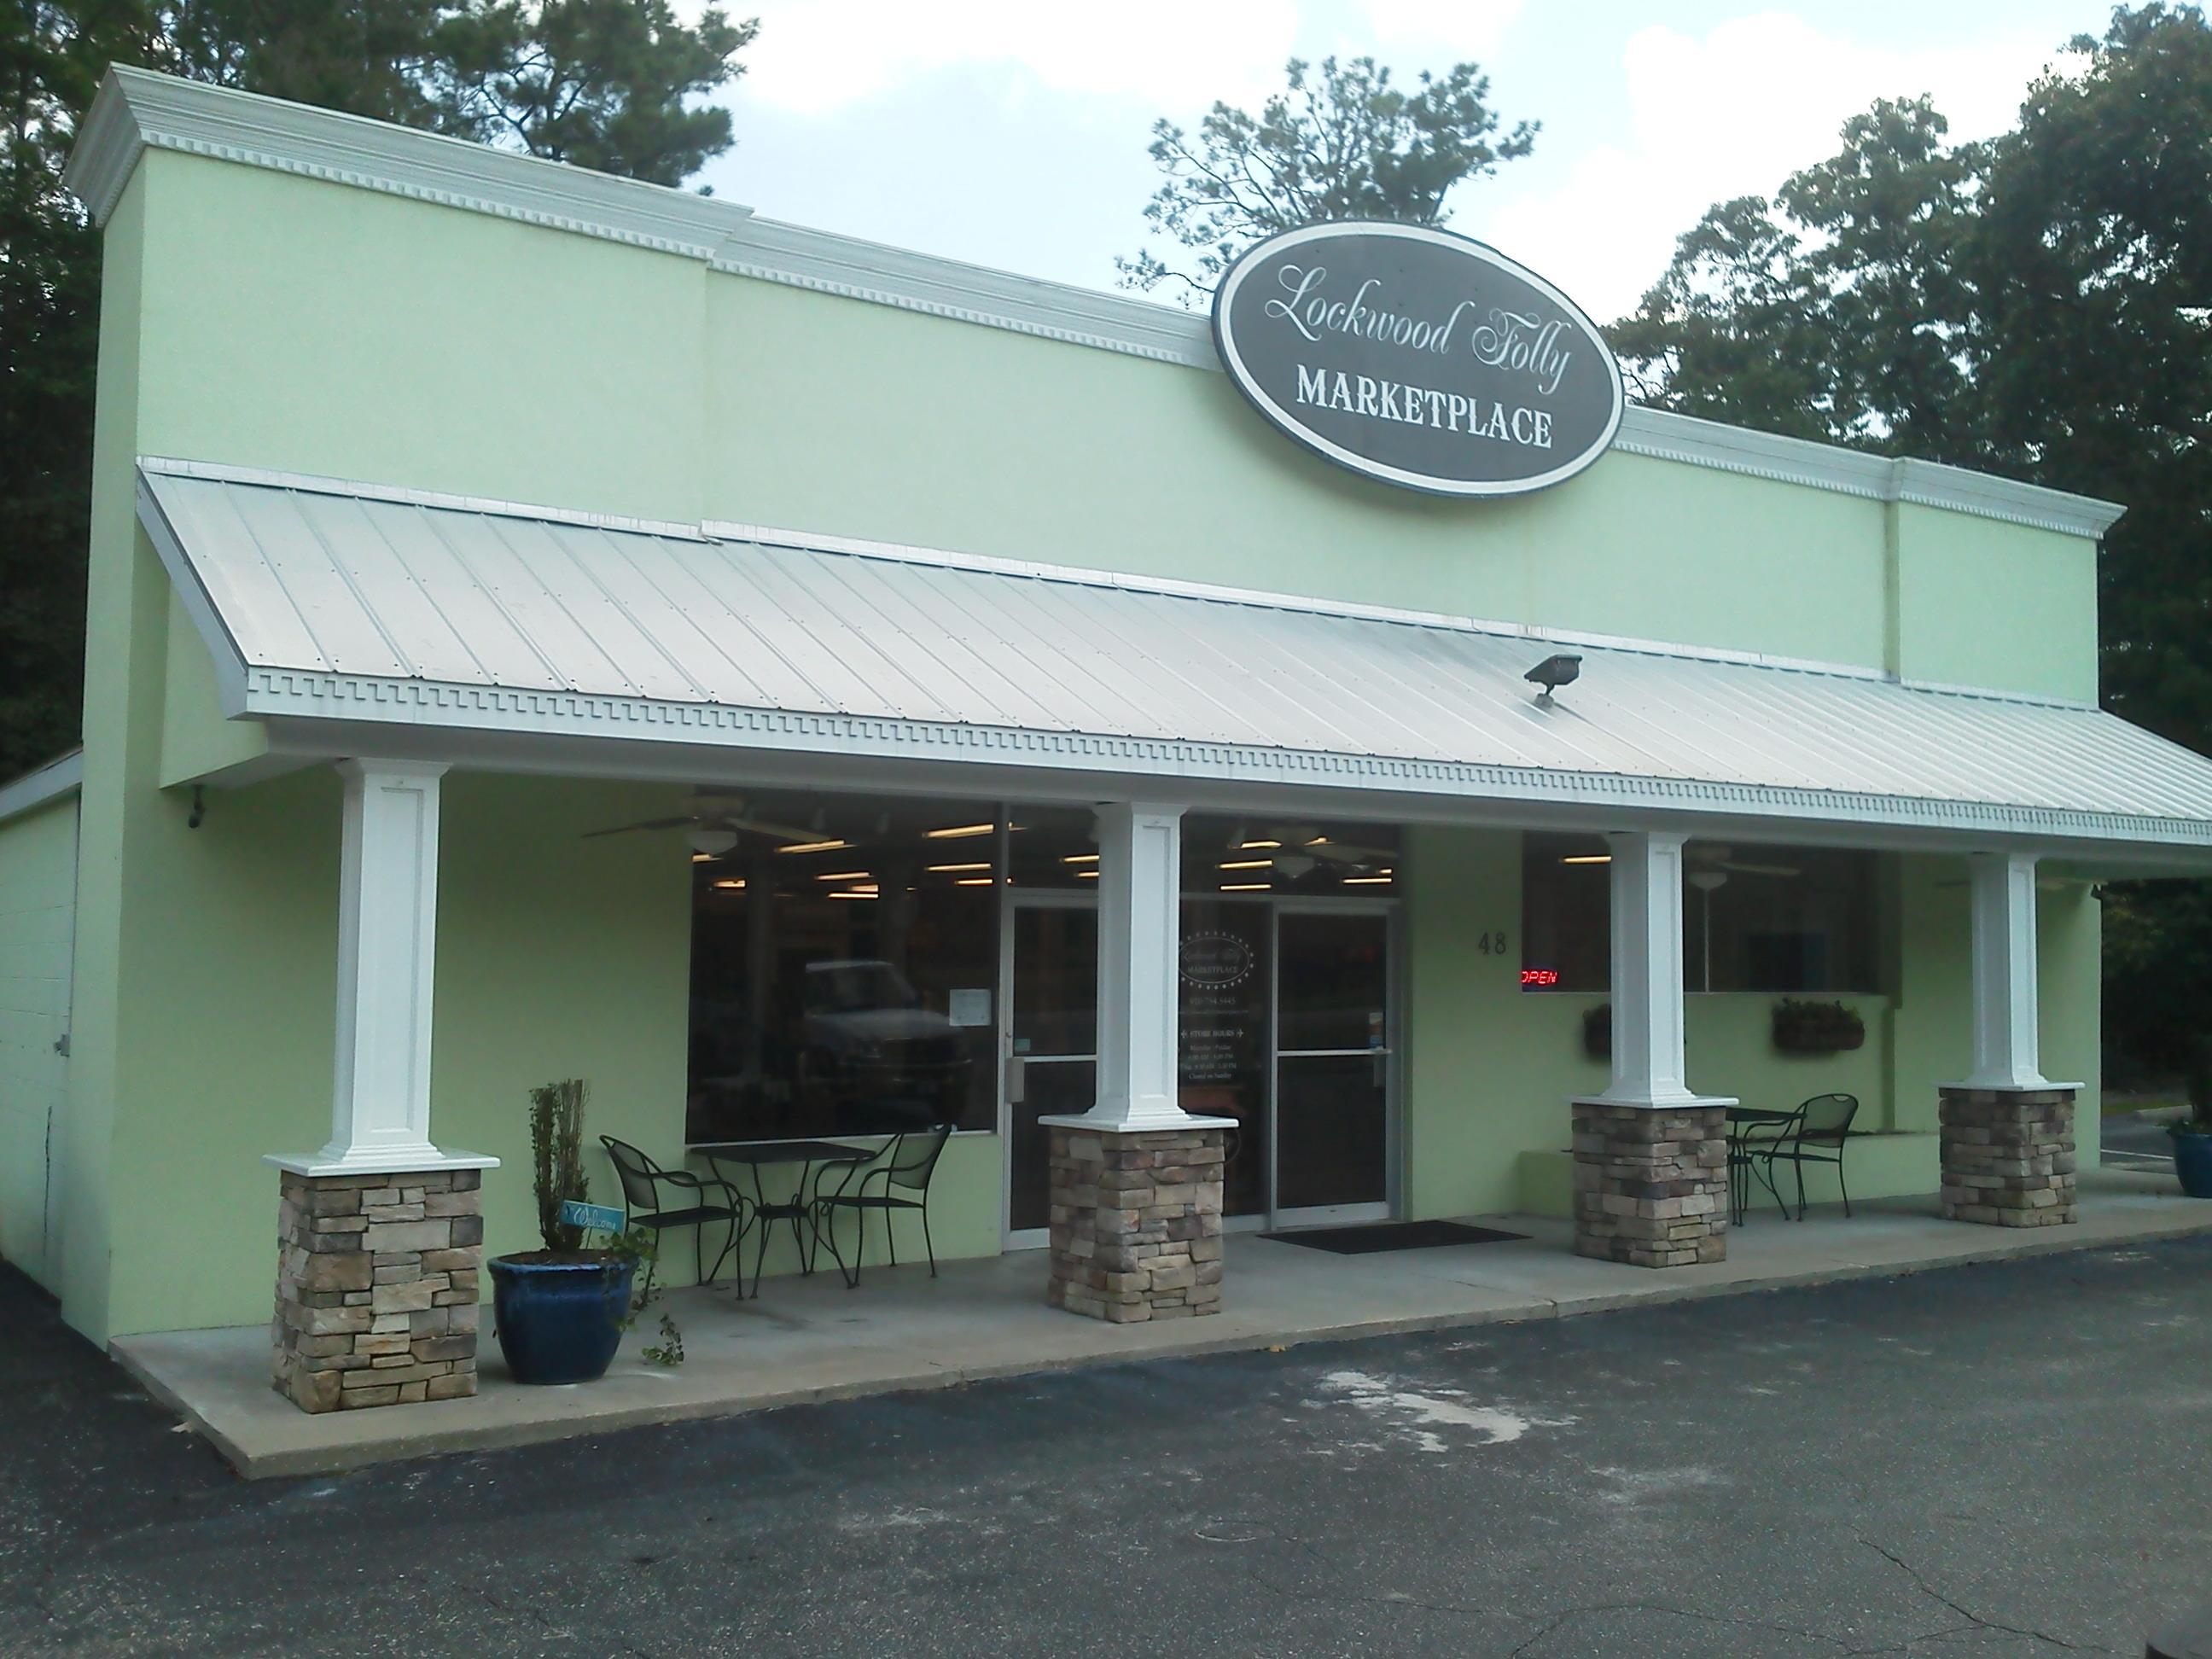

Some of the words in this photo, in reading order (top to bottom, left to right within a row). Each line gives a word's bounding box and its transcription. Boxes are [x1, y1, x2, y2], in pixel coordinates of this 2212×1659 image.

[1265, 265, 1475, 355] Lockwood
[1472, 308, 1572, 395] Folly
[1295, 364, 1552, 449] MARKETPLACE
[1478, 931, 1506, 955] 48
[1522, 970, 1557, 985] OPEN
